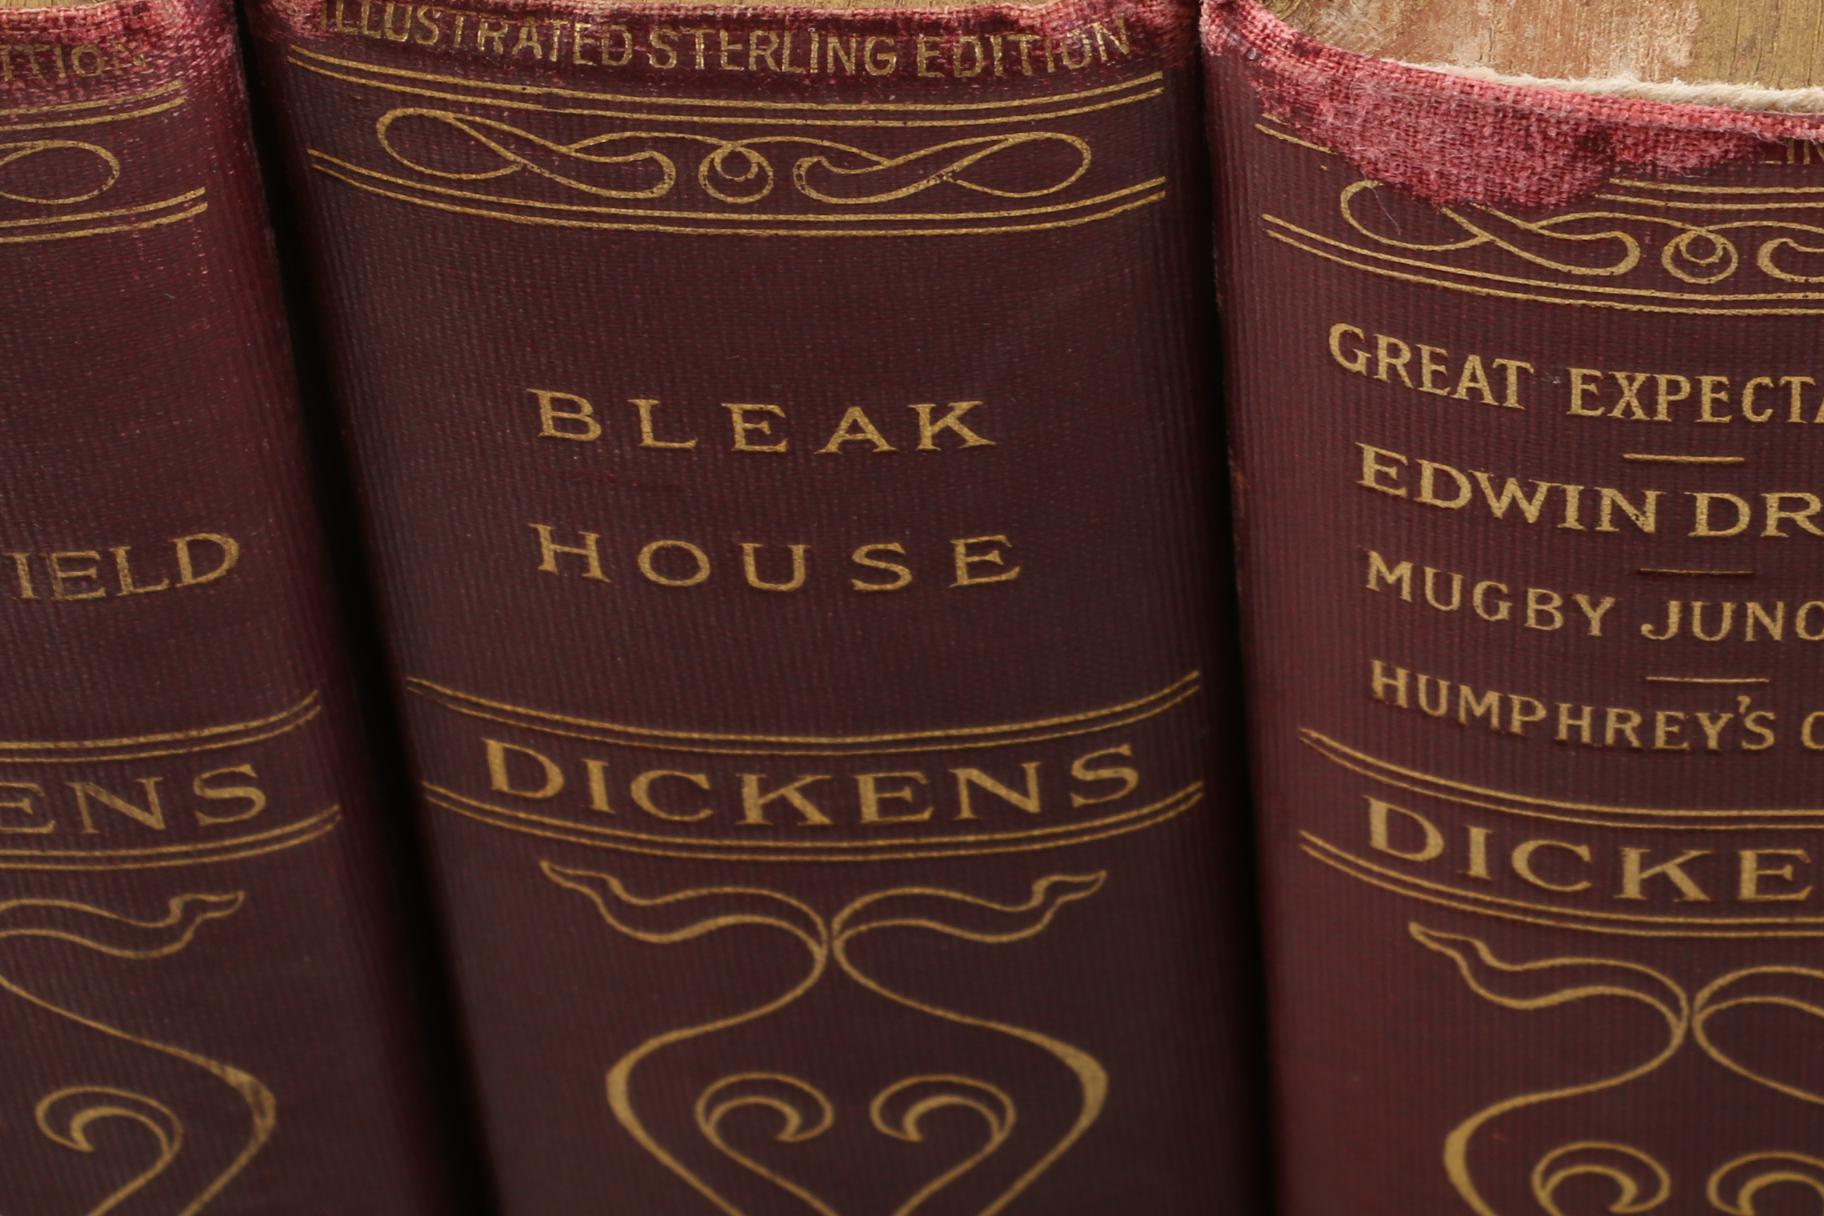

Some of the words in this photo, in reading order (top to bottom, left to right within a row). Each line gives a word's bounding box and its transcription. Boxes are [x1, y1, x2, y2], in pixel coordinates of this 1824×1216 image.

[647, 22, 898, 76] STERLING
[916, 17, 1131, 79] EDITION
[1328, 322, 1534, 410] GREAT
[528, 388, 997, 455] BLEAK
[1354, 441, 1666, 536] EDWIN
[528, 523, 1021, 592] HOUSE
[1363, 549, 1616, 637] MUGBY
[1369, 659, 1777, 753] HUMPHREY'S
[480, 737, 1140, 827] DICKENS
